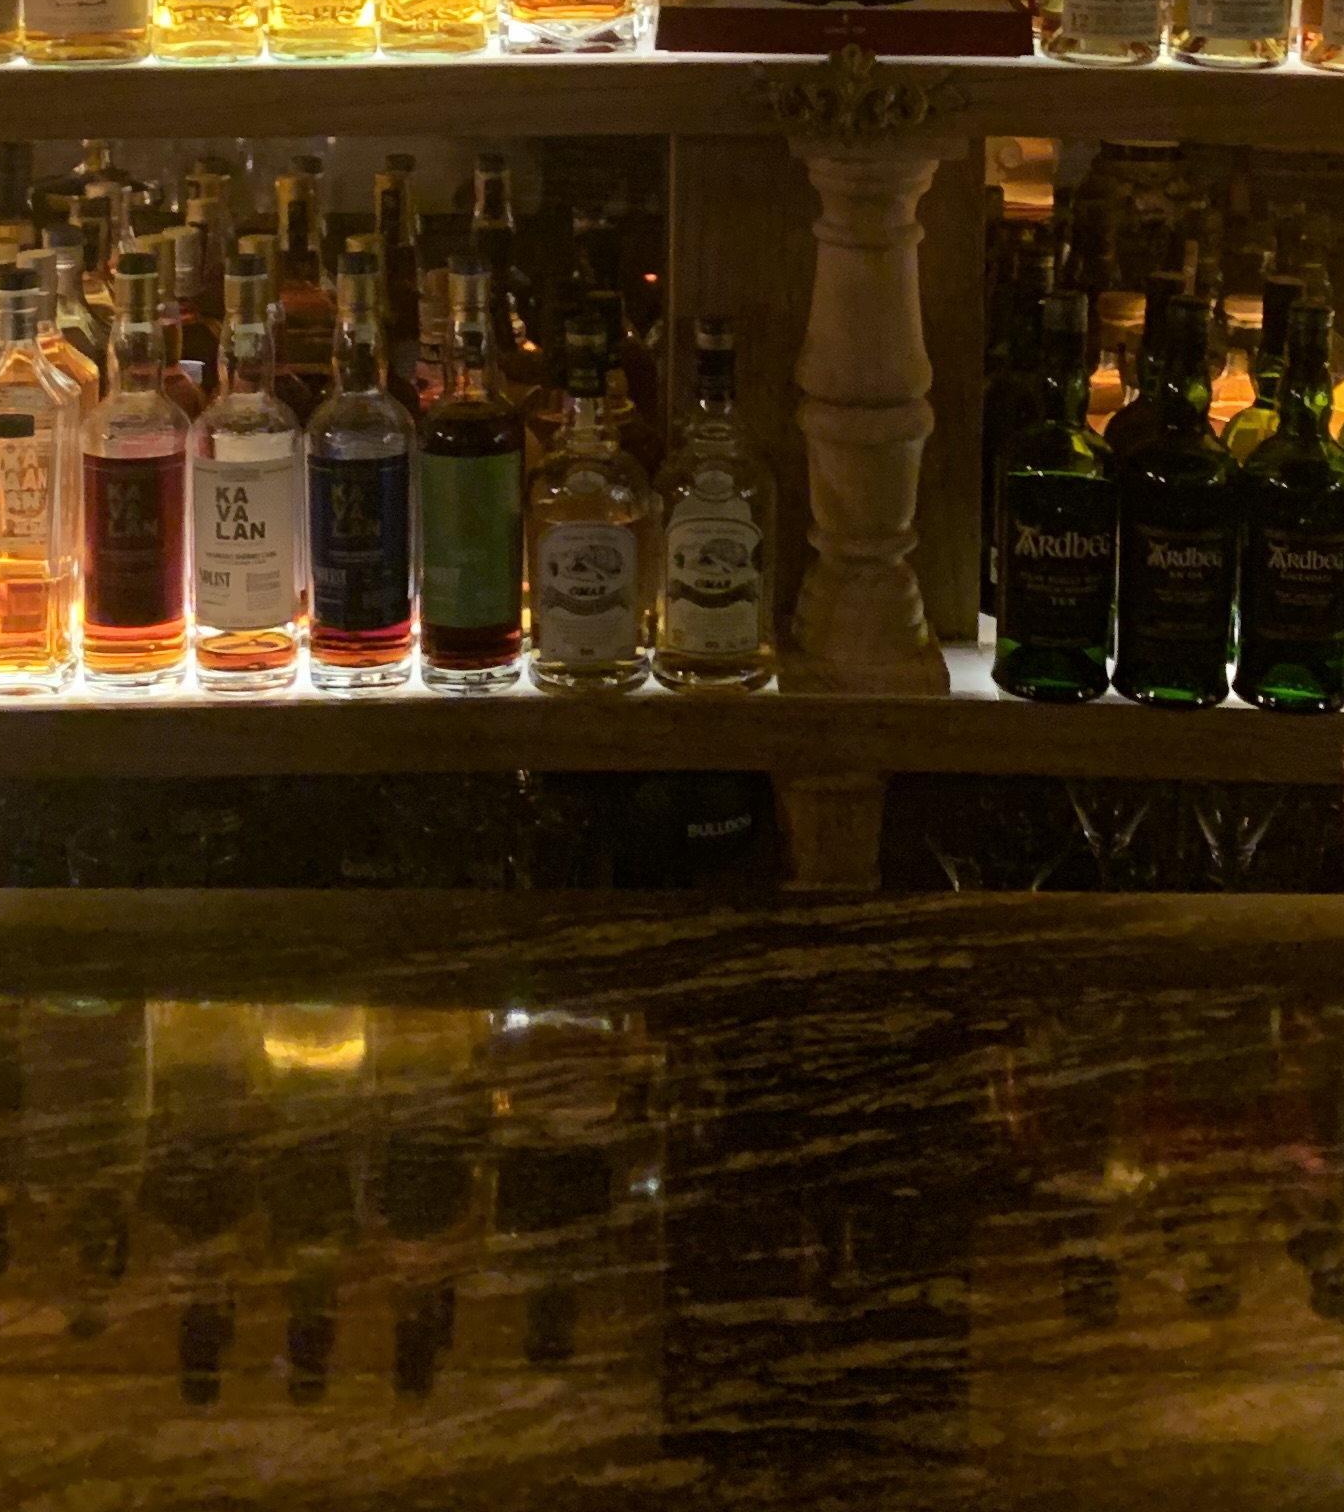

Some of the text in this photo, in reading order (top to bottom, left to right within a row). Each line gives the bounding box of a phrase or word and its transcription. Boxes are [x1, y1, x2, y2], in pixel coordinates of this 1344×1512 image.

[215, 486, 248, 503] KA
[216, 505, 249, 521] VA
[216, 522, 266, 540] LAN
[695, 579, 732, 589] OMAR
